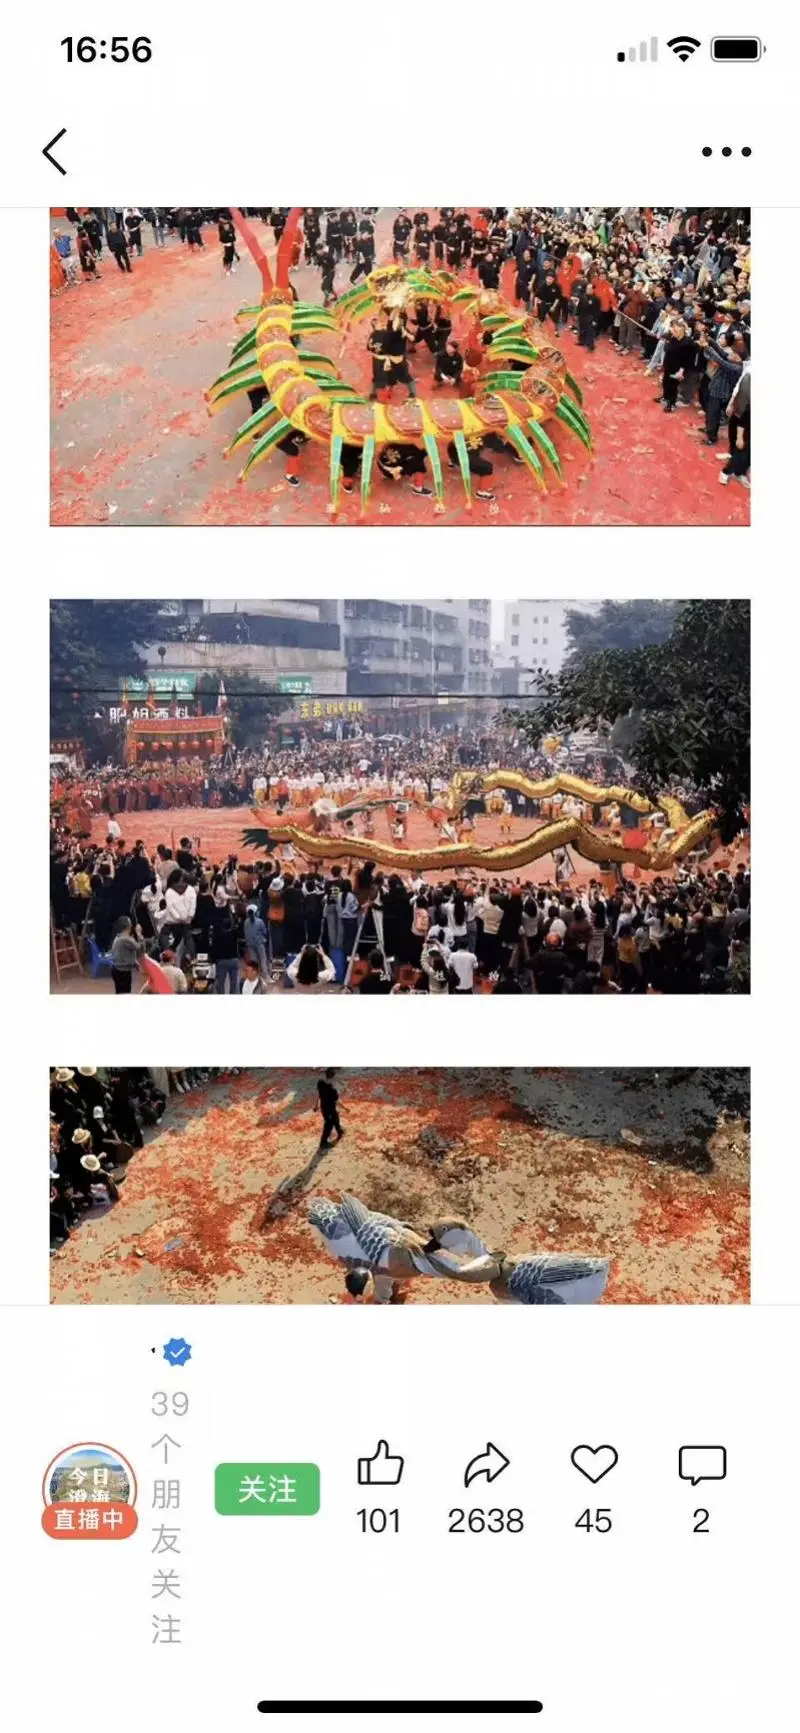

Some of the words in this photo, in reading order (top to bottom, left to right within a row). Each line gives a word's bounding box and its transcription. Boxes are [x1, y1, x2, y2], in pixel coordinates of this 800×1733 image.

[60, 35, 152, 64] 16:56
[69, 1467, 109, 1486] 今日
[238, 1475, 298, 1504] 关注
[53, 1508, 124, 1532] 直播中
[356, 1508, 400, 1534] 101
[448, 1507, 525, 1534] 2638
[574, 1508, 613, 1534] 45
[692, 1508, 710, 1534] 2
